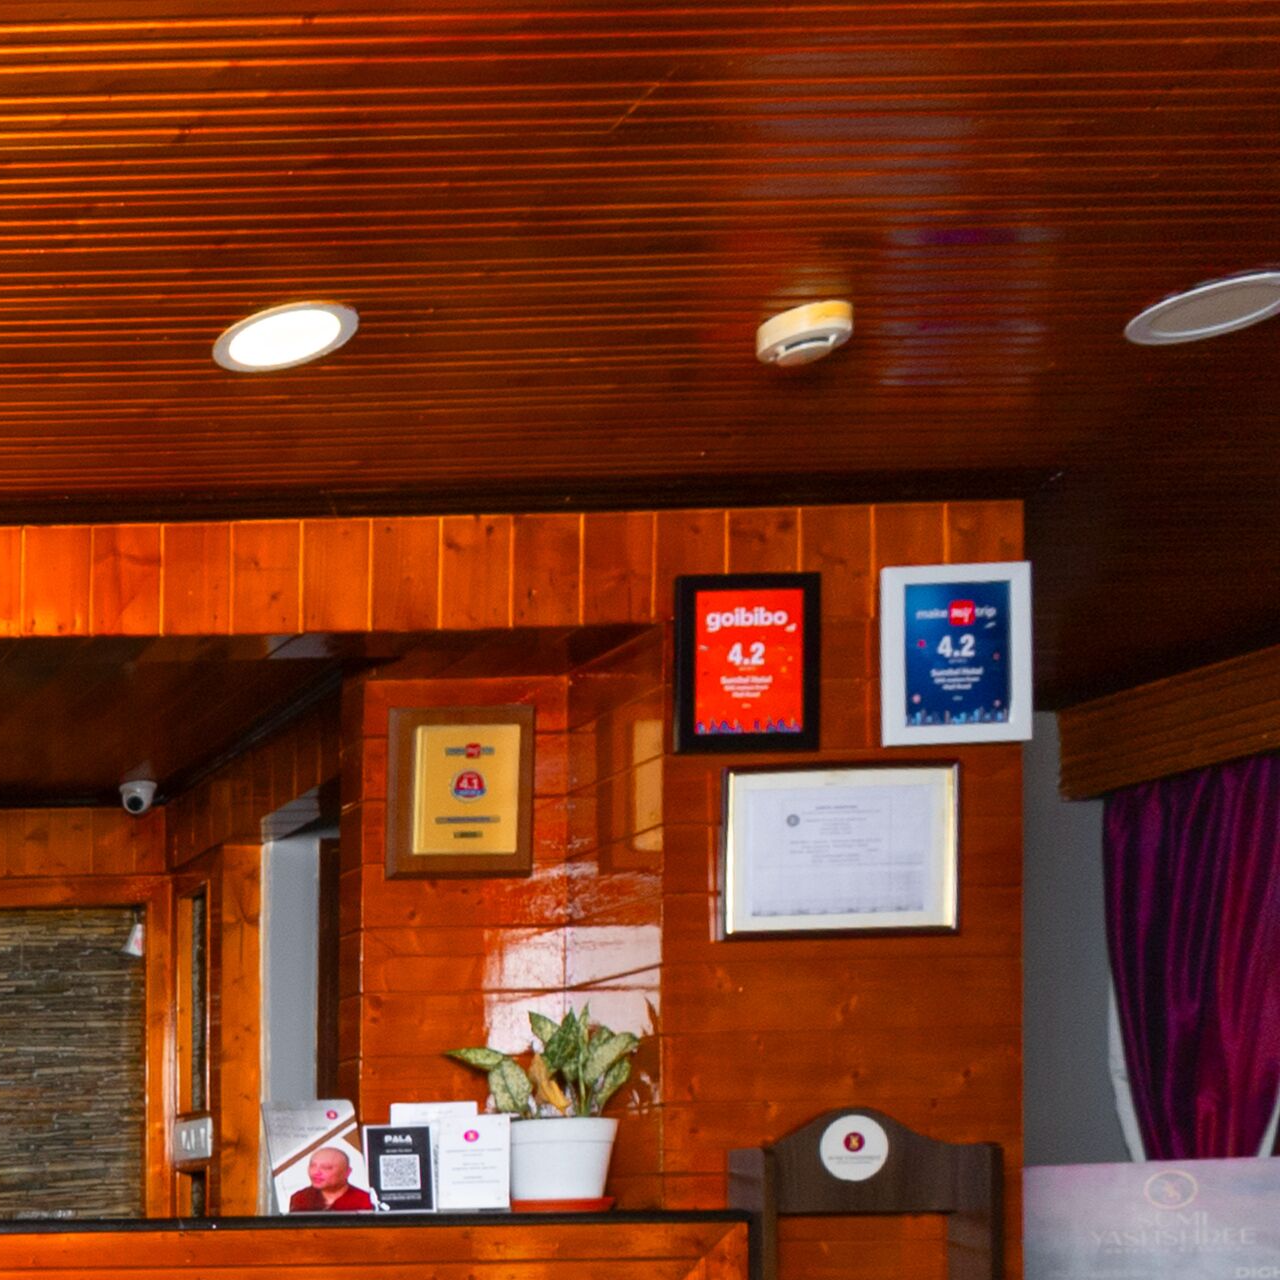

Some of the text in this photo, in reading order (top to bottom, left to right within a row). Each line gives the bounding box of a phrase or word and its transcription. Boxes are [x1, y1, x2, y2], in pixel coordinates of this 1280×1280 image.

[706, 607, 788, 632] goibibo
[727, 642, 765, 666] 4.2
[937, 634, 975, 657] 4.2
[384, 1135, 413, 1144] PALA
